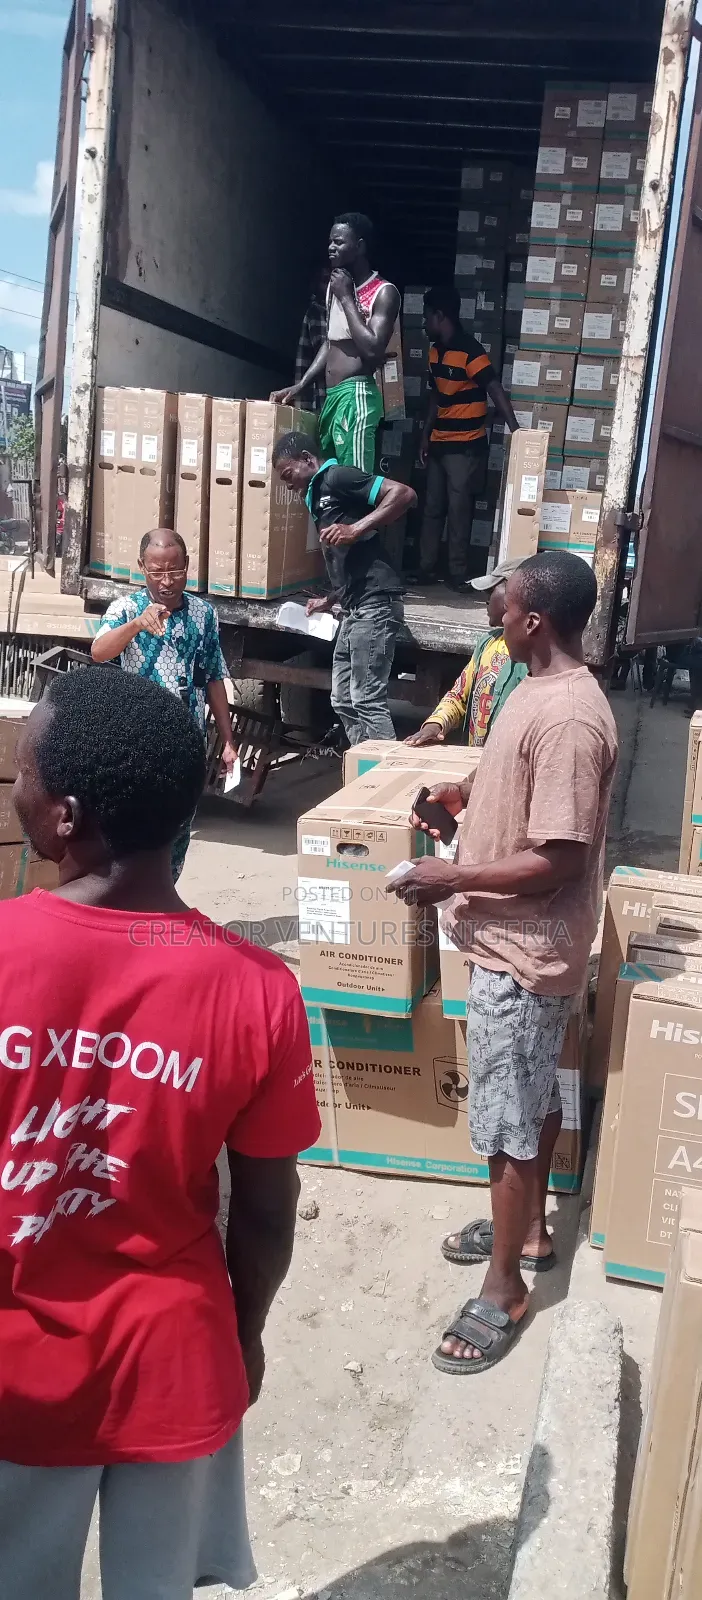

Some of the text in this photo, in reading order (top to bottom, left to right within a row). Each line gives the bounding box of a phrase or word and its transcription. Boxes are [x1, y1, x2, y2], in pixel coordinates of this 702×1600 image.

[326, 857, 386, 873] Hisense
[319, 950, 404, 966] AIR CONDITIONER
[337, 981, 381, 992] Outdoor Unit
[650, 1020, 702, 1045] His
[40, 1028, 204, 1093] XBOOM
[329, 1060, 422, 1077] CONDITIONER
[345, 1102, 366, 1111] Unit
[673, 1091, 702, 1120] S
[11, 1095, 137, 1151] LIGHT
[386, 1156, 479, 1175] Hisense Corporation
[1, 1158, 58, 1196] UP
[663, 1202, 679, 1212] CL
